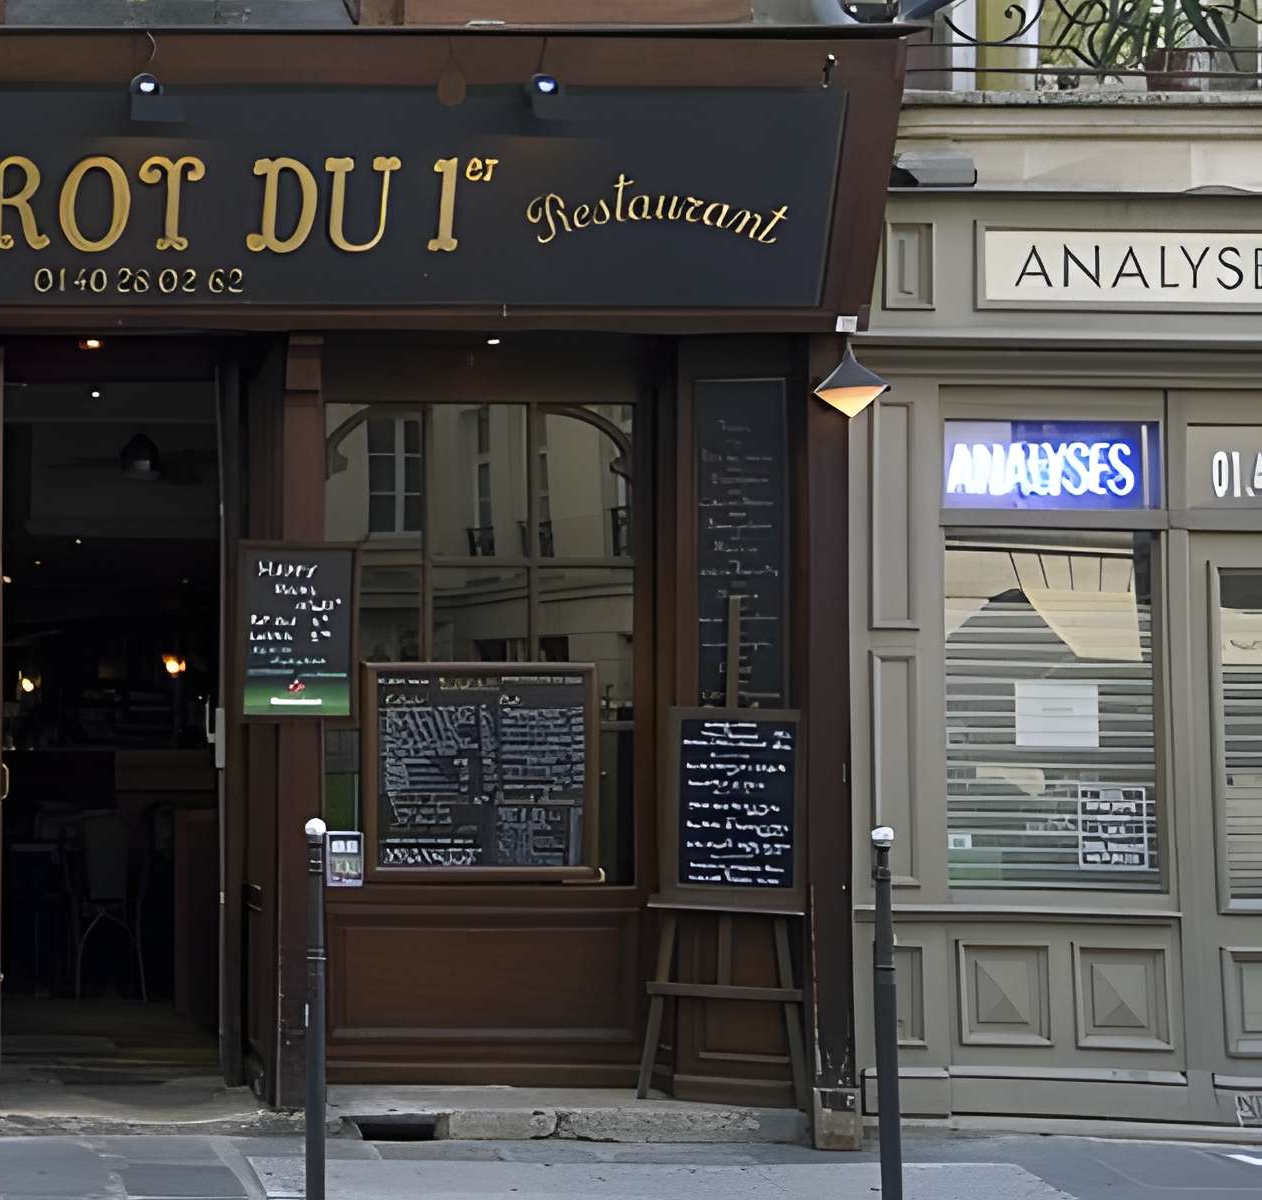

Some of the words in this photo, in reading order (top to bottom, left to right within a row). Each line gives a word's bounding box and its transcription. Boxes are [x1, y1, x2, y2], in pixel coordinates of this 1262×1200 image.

[245, 155, 402, 254] DU
[526, 173, 789, 244] Restaurant
[945, 442, 1136, 497] ANALYSES
